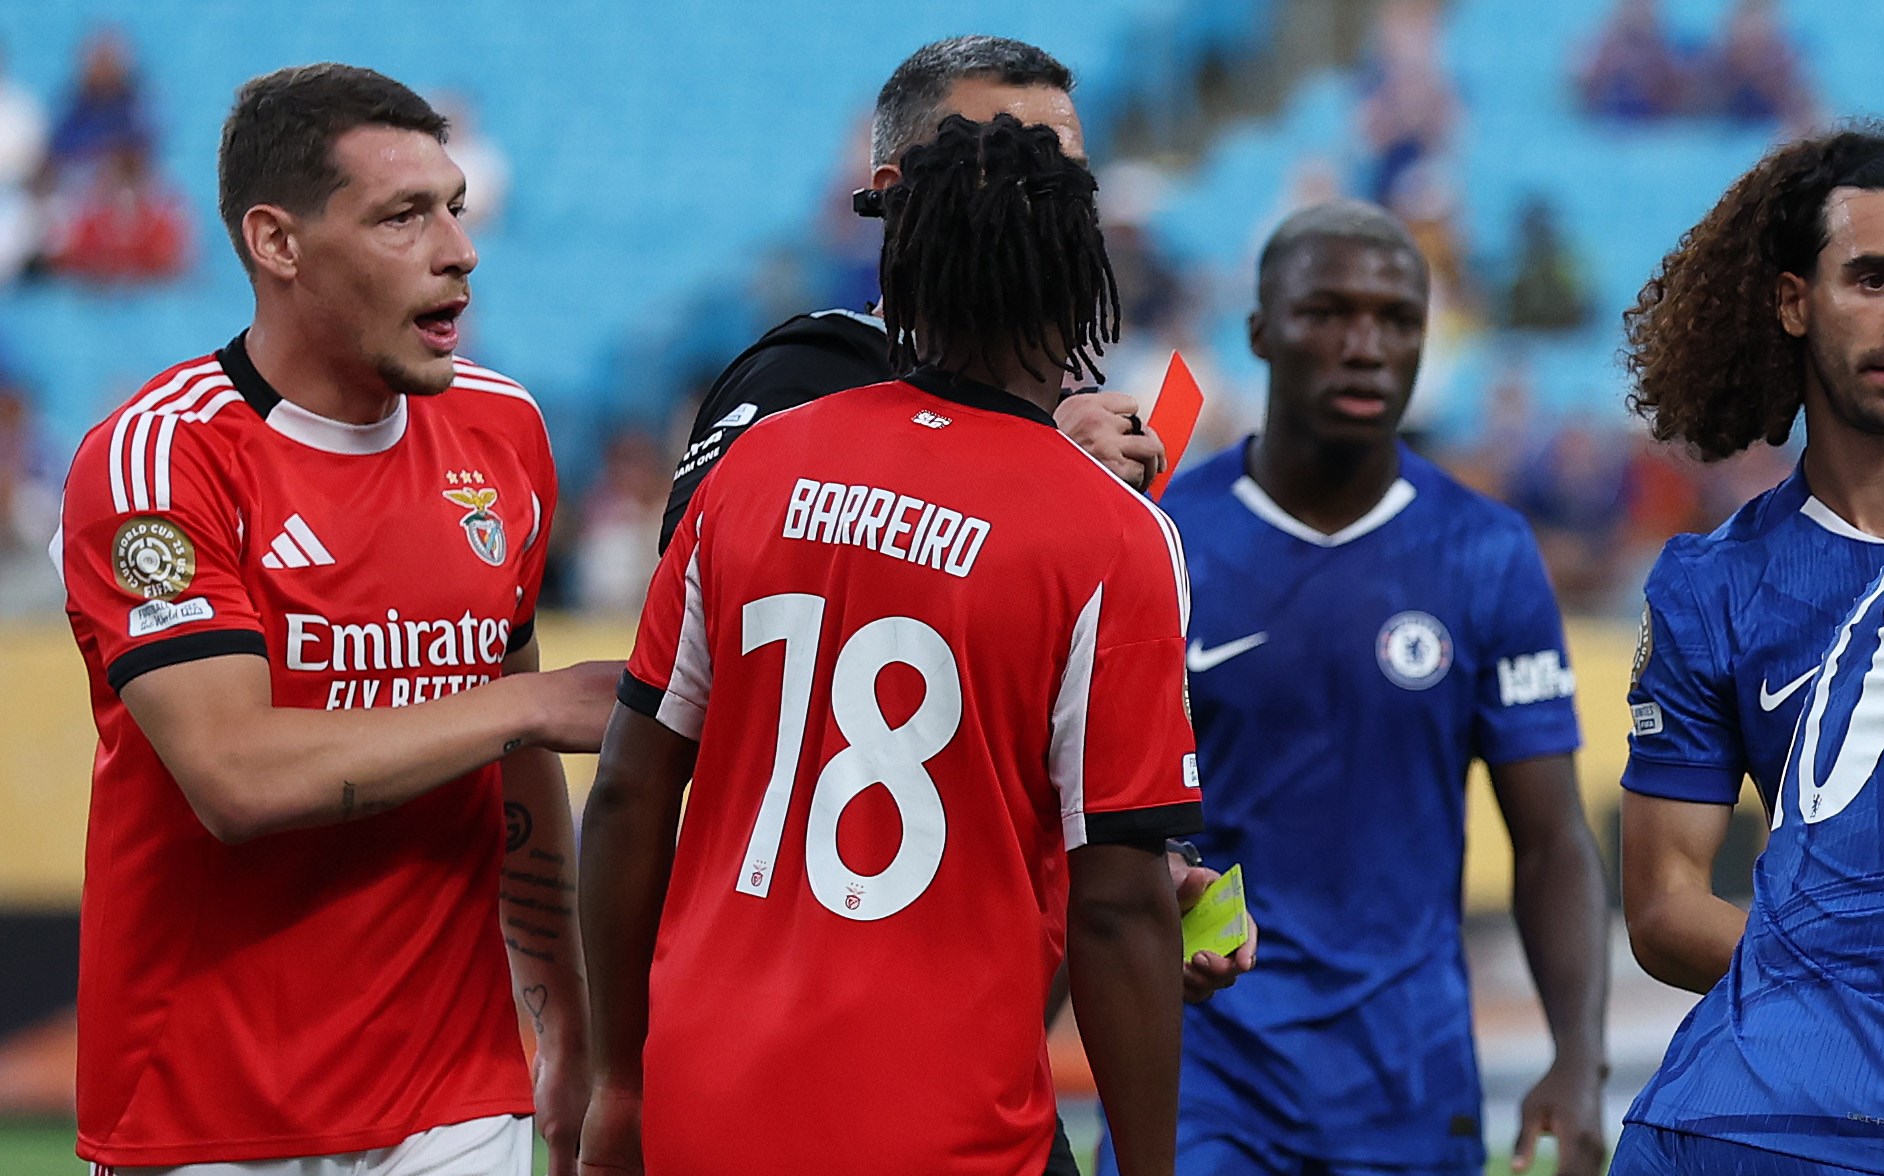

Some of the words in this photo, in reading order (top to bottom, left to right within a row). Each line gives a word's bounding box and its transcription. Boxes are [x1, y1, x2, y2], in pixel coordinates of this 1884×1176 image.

[696, 446, 720, 467] ONE
[118, 524, 147, 557] WORLD
[150, 524, 175, 539] CUP
[783, 478, 991, 578] BARREIRO
[119, 560, 139, 588] CLUB
[143, 580, 174, 599] FIFA
[285, 608, 511, 671] Emirates
[736, 592, 962, 921] 18
